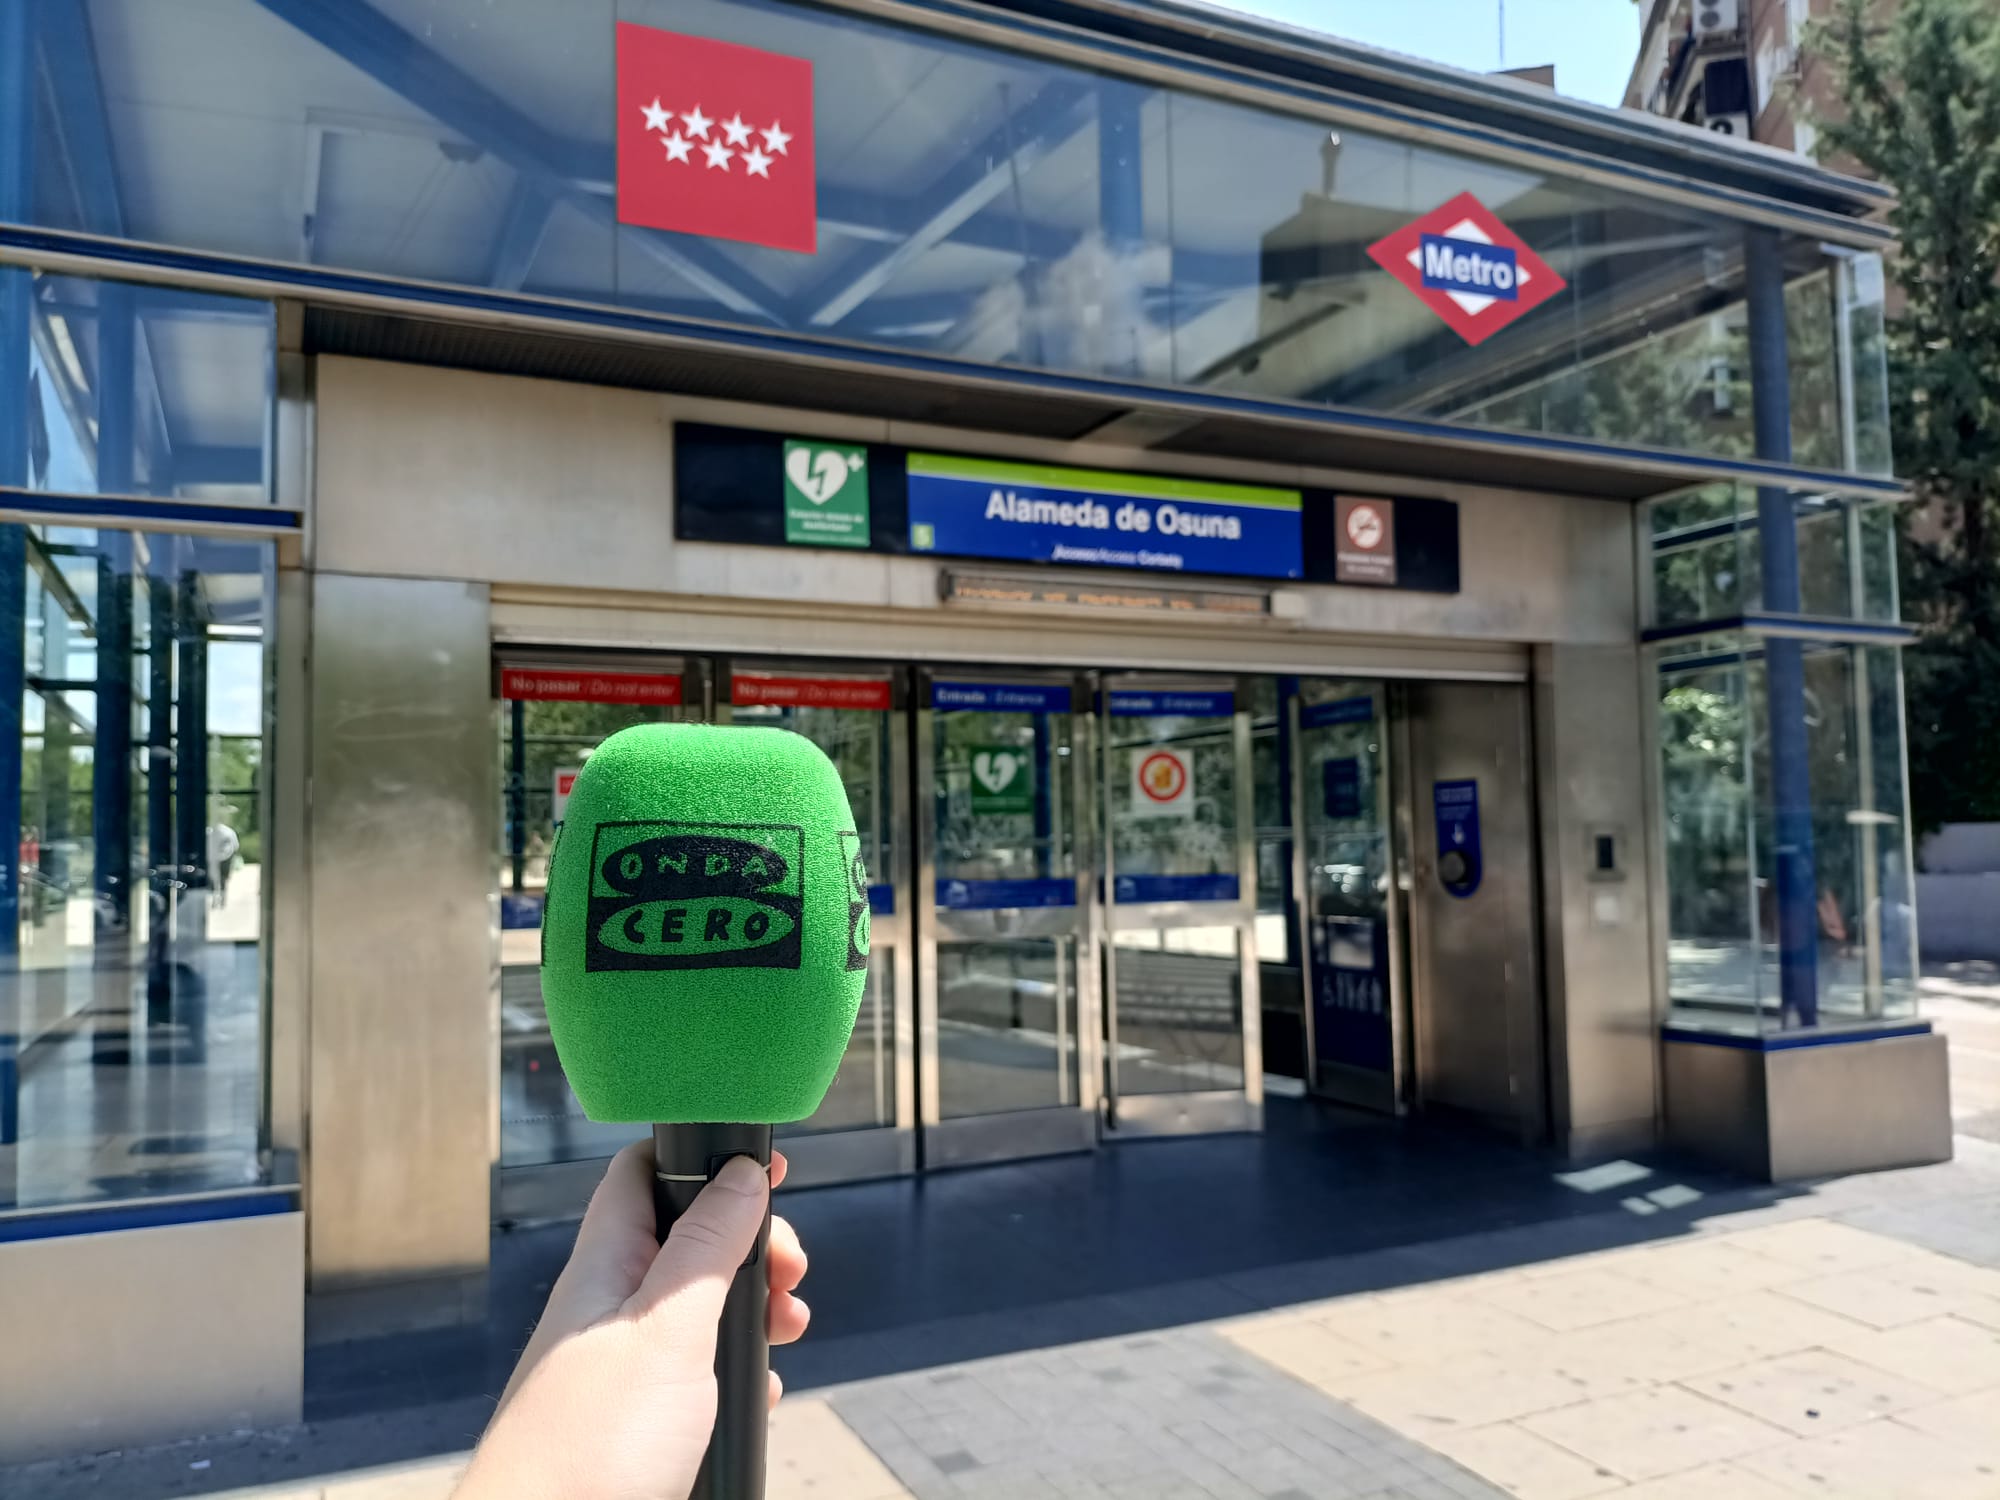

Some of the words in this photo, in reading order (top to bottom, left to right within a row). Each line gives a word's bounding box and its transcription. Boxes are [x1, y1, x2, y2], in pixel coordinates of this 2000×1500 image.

[1425, 243, 1514, 290] Metro
[984, 490, 1110, 530] Alameda
[1115, 502, 1151, 532] de
[1156, 504, 1242, 540] Osuna
[511, 676, 534, 692] No
[536, 680, 580, 695] pasar
[591, 679, 613, 695] Do
[616, 682, 638, 696] not
[639, 683, 675, 697] enter
[619, 851, 769, 881] ONDA
[622, 907, 771, 945] CERO
